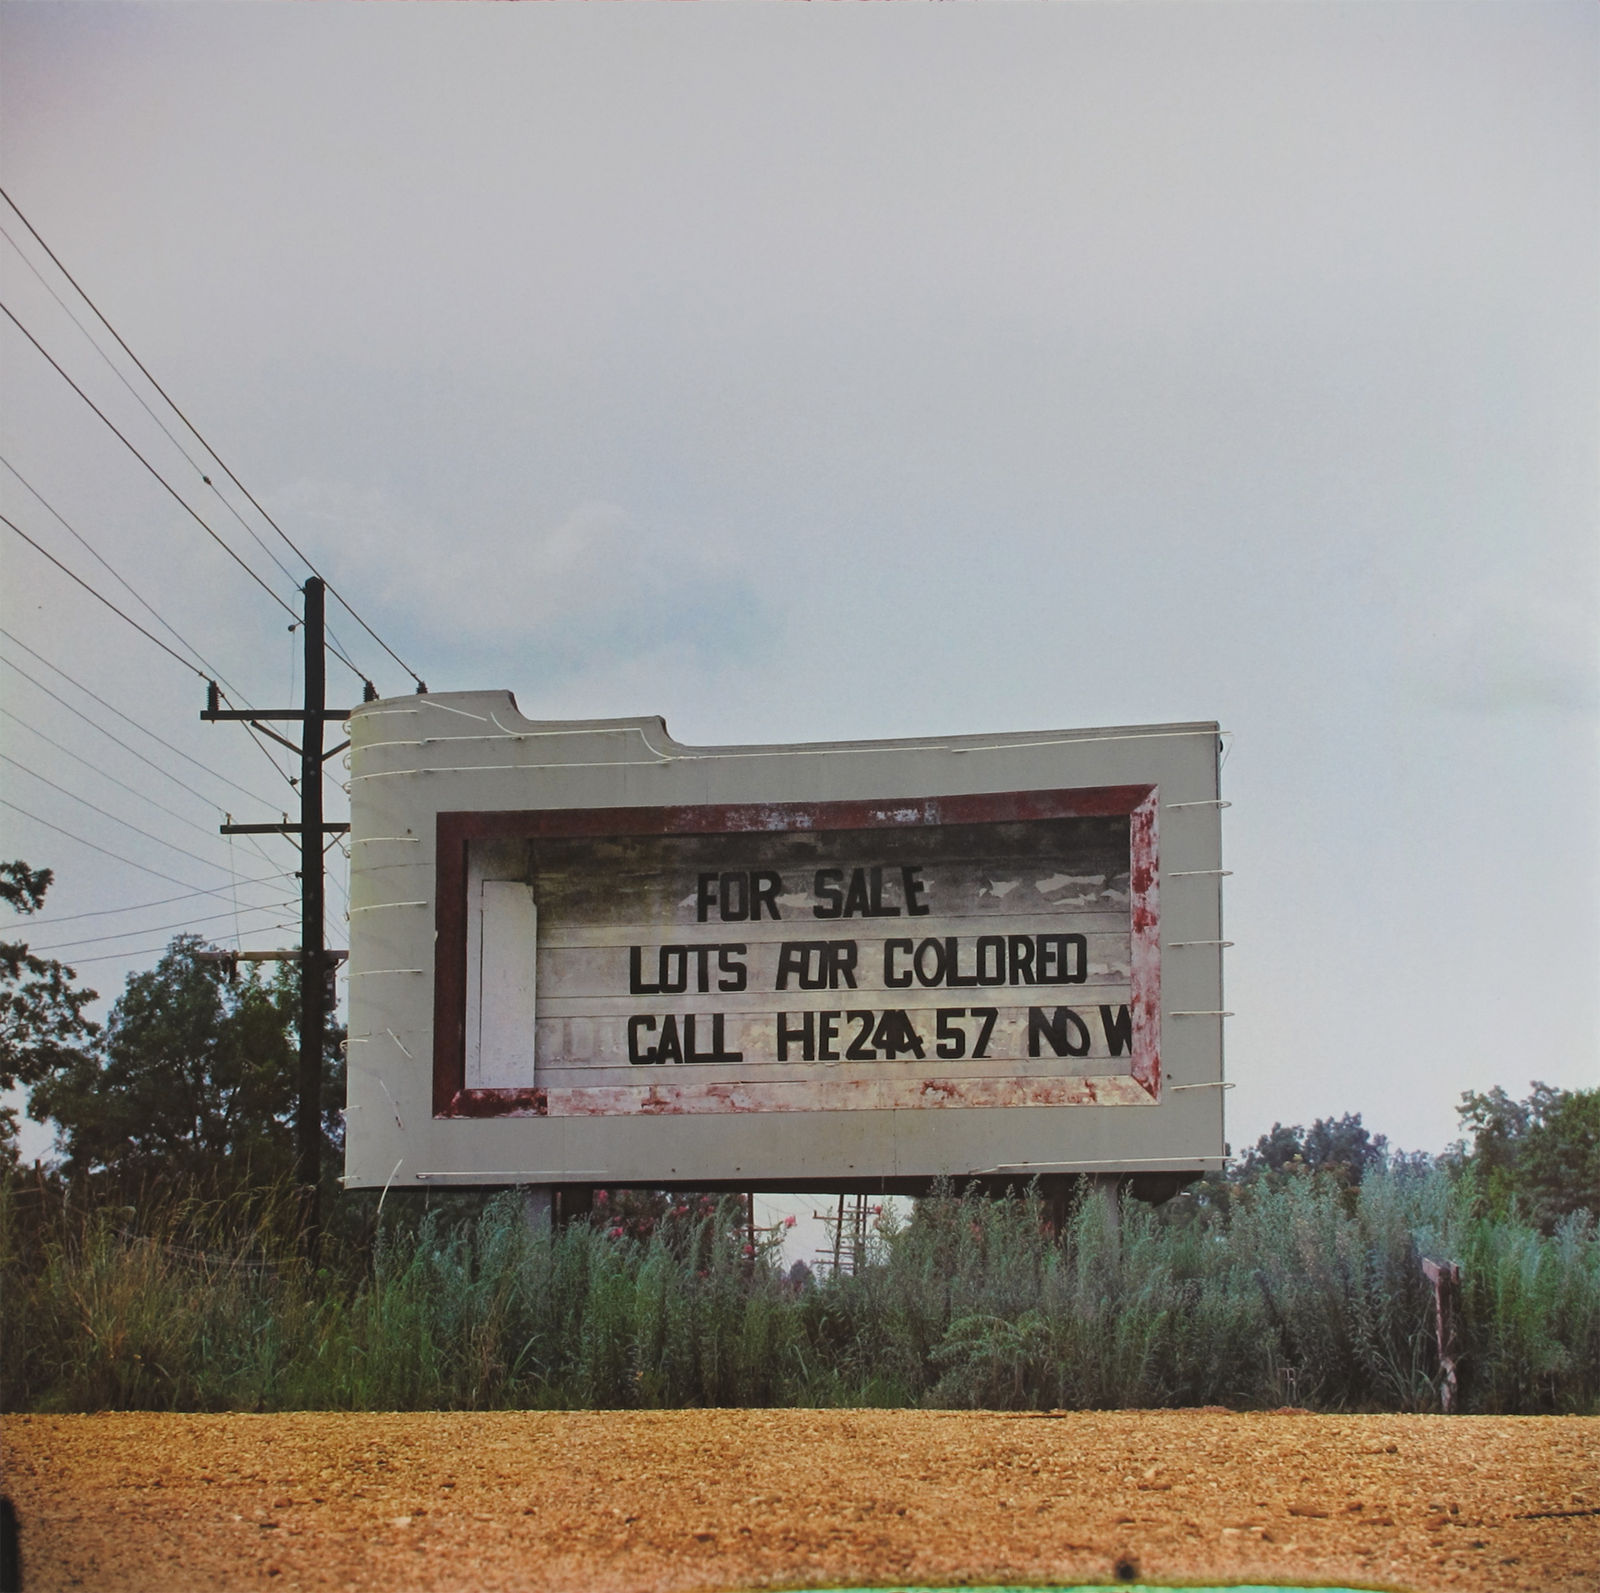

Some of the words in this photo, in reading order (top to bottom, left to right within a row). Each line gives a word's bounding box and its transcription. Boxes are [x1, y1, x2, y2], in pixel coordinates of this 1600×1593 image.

[697, 870, 782, 922] FOR
[813, 866, 930, 919] SALE
[629, 943, 748, 994] LOTS
[775, 940, 858, 990] FOR
[884, 933, 1088, 988] COLORED
[627, 1013, 744, 1065] CALL
